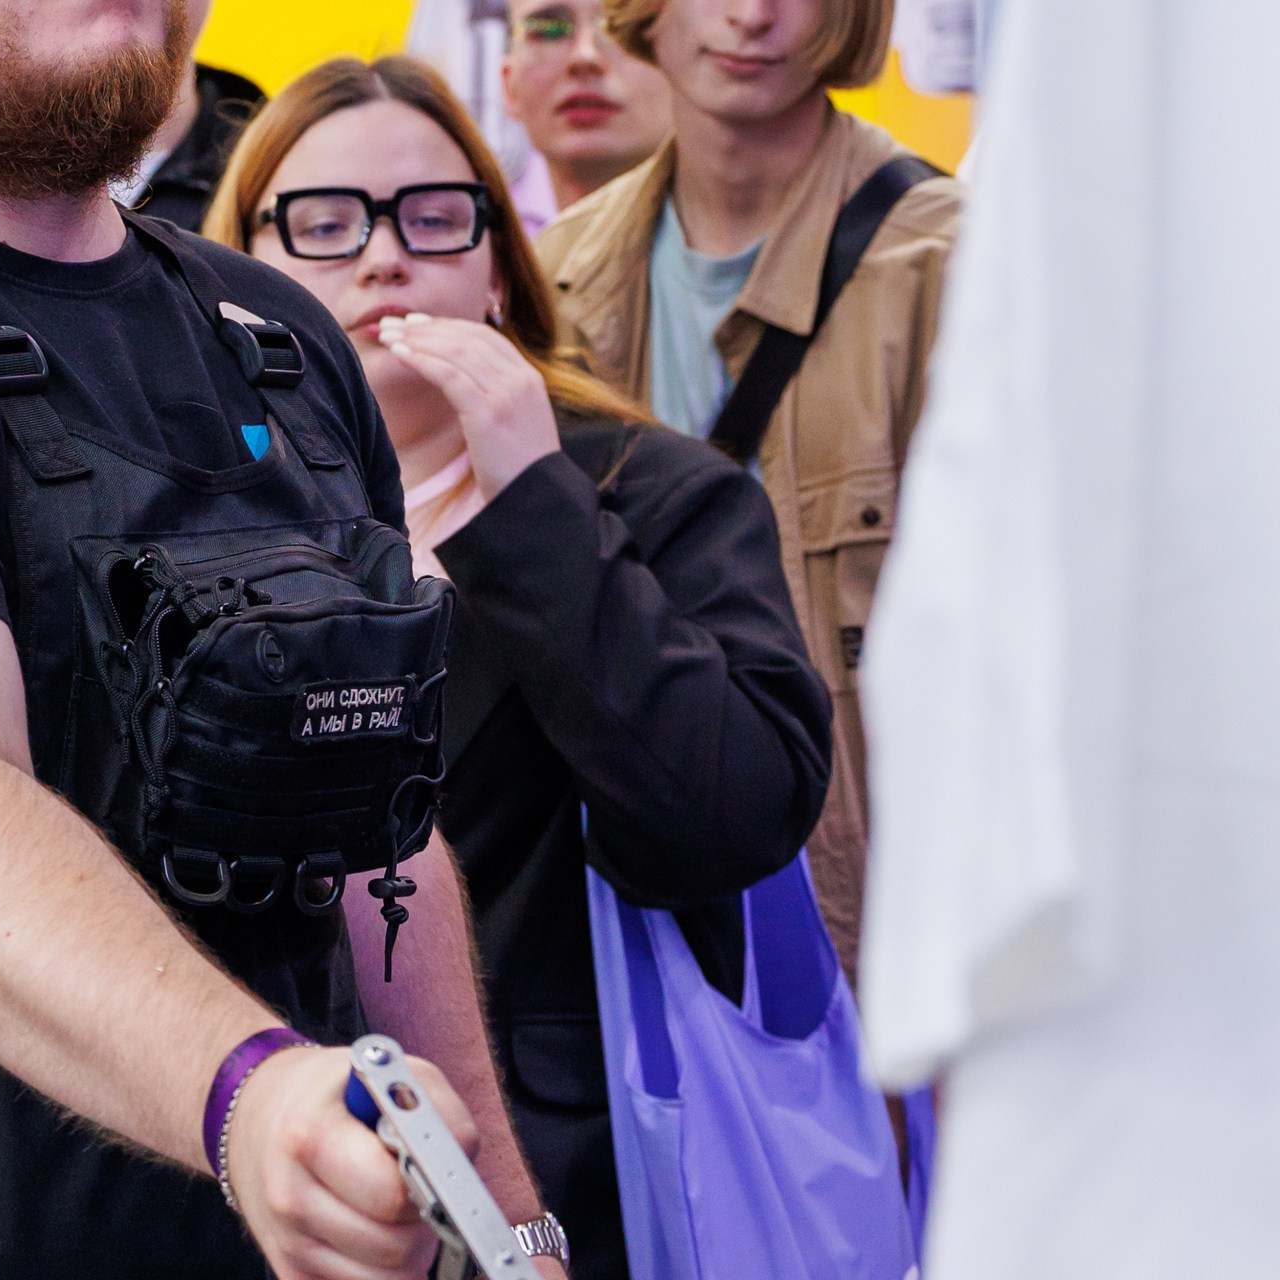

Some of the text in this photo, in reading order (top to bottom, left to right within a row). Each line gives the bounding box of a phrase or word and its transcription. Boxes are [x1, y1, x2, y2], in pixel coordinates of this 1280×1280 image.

[306, 690, 335, 711] ОНИ
[301, 706, 403, 737] А МЫ В РАЙ!
